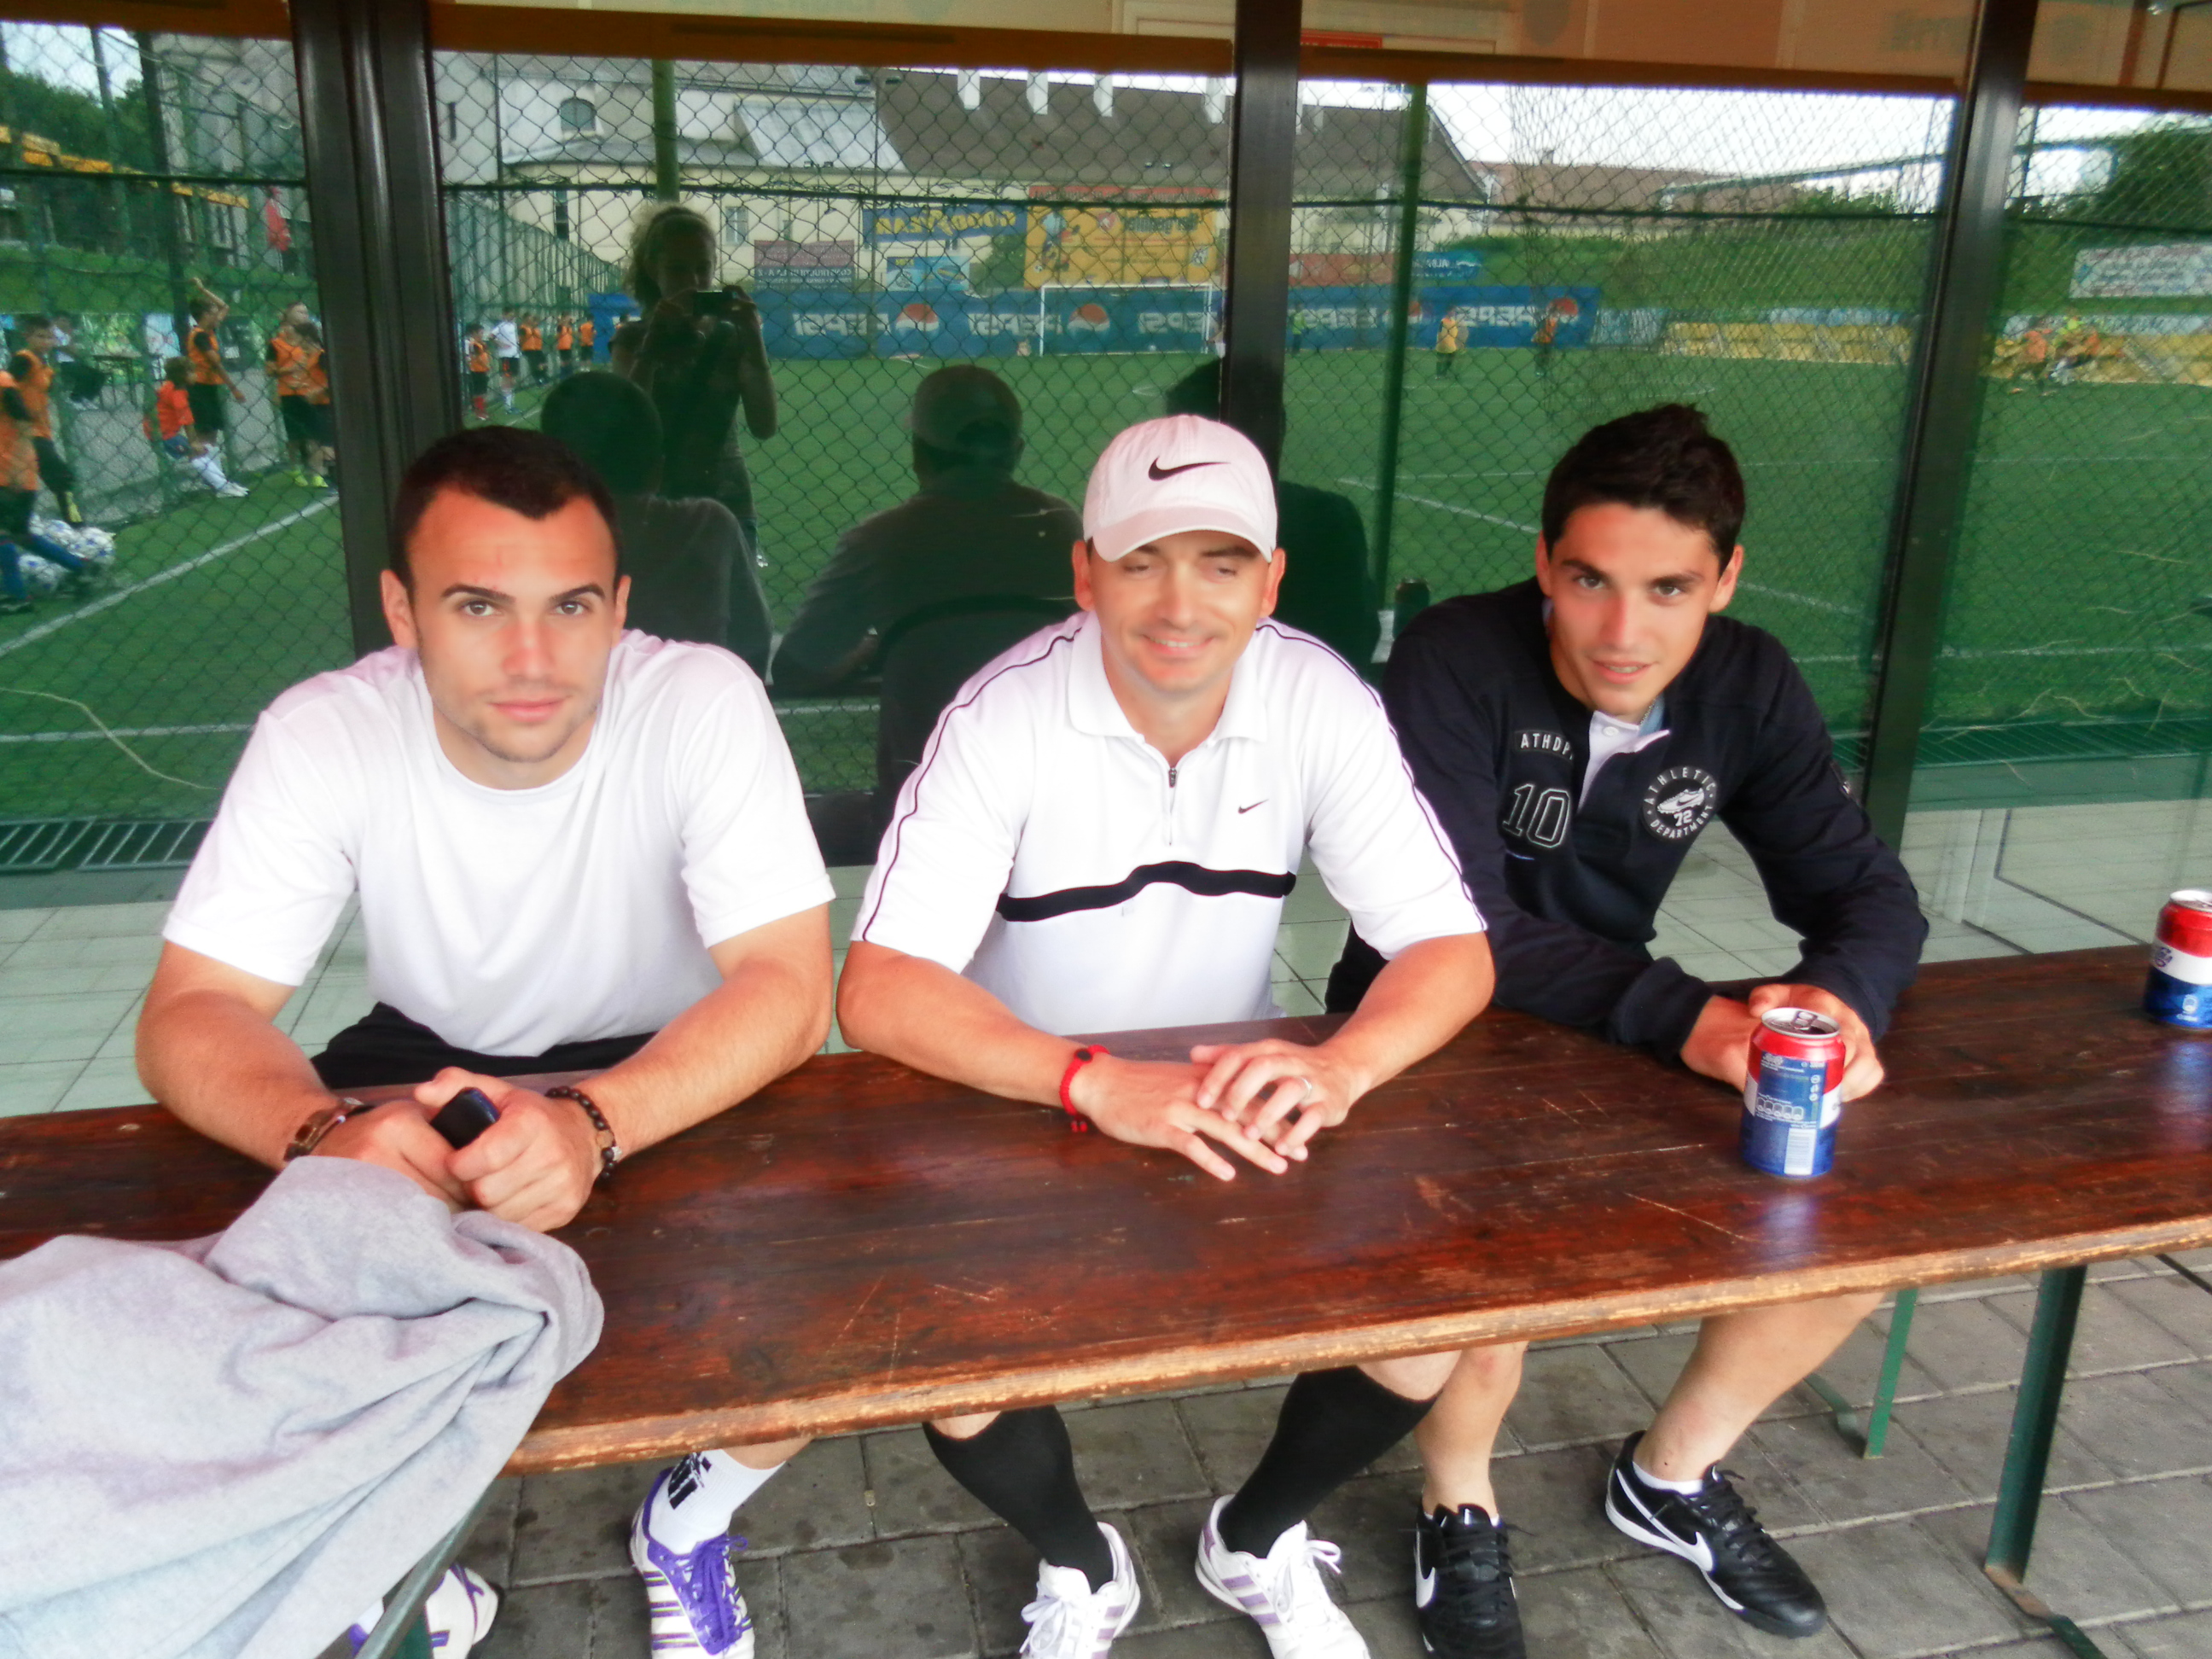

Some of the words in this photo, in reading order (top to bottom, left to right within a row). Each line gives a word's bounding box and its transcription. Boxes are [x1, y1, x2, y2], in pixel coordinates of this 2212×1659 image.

[1520, 732, 1575, 760] ATHDP
[1644, 767, 1717, 804] ATHLETIC
[1502, 783, 1571, 848] 10
[1649, 805, 1714, 839] DEPARTMENT
[1674, 810, 1693, 826] 72
